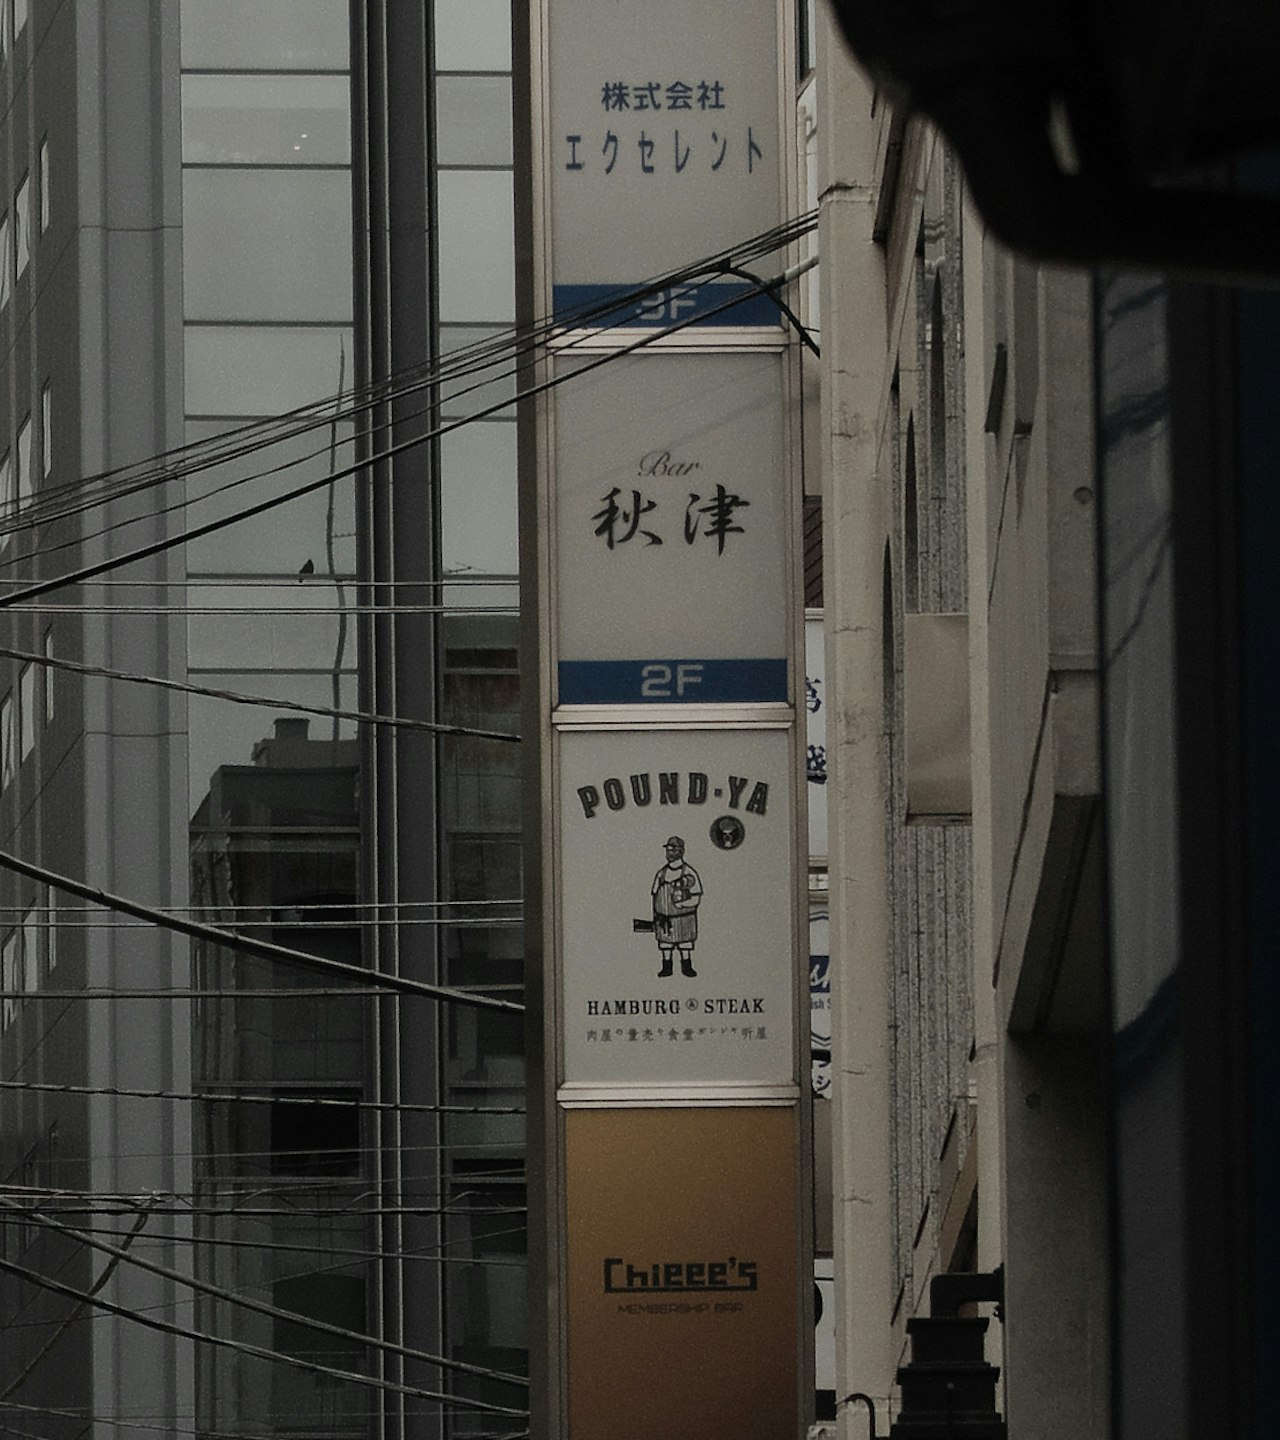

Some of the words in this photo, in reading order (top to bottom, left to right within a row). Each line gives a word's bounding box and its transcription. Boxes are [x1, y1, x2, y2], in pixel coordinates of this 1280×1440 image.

[601, 81, 725, 111] 株式会社
[565, 126, 763, 174] エクセレント
[635, 288, 698, 320] 3F
[638, 451, 699, 477] Bar
[590, 483, 750, 558] 秋津
[640, 664, 704, 697] 2F
[587, 999, 680, 1016] HAMBURG
[703, 998, 766, 1014] STEAK
